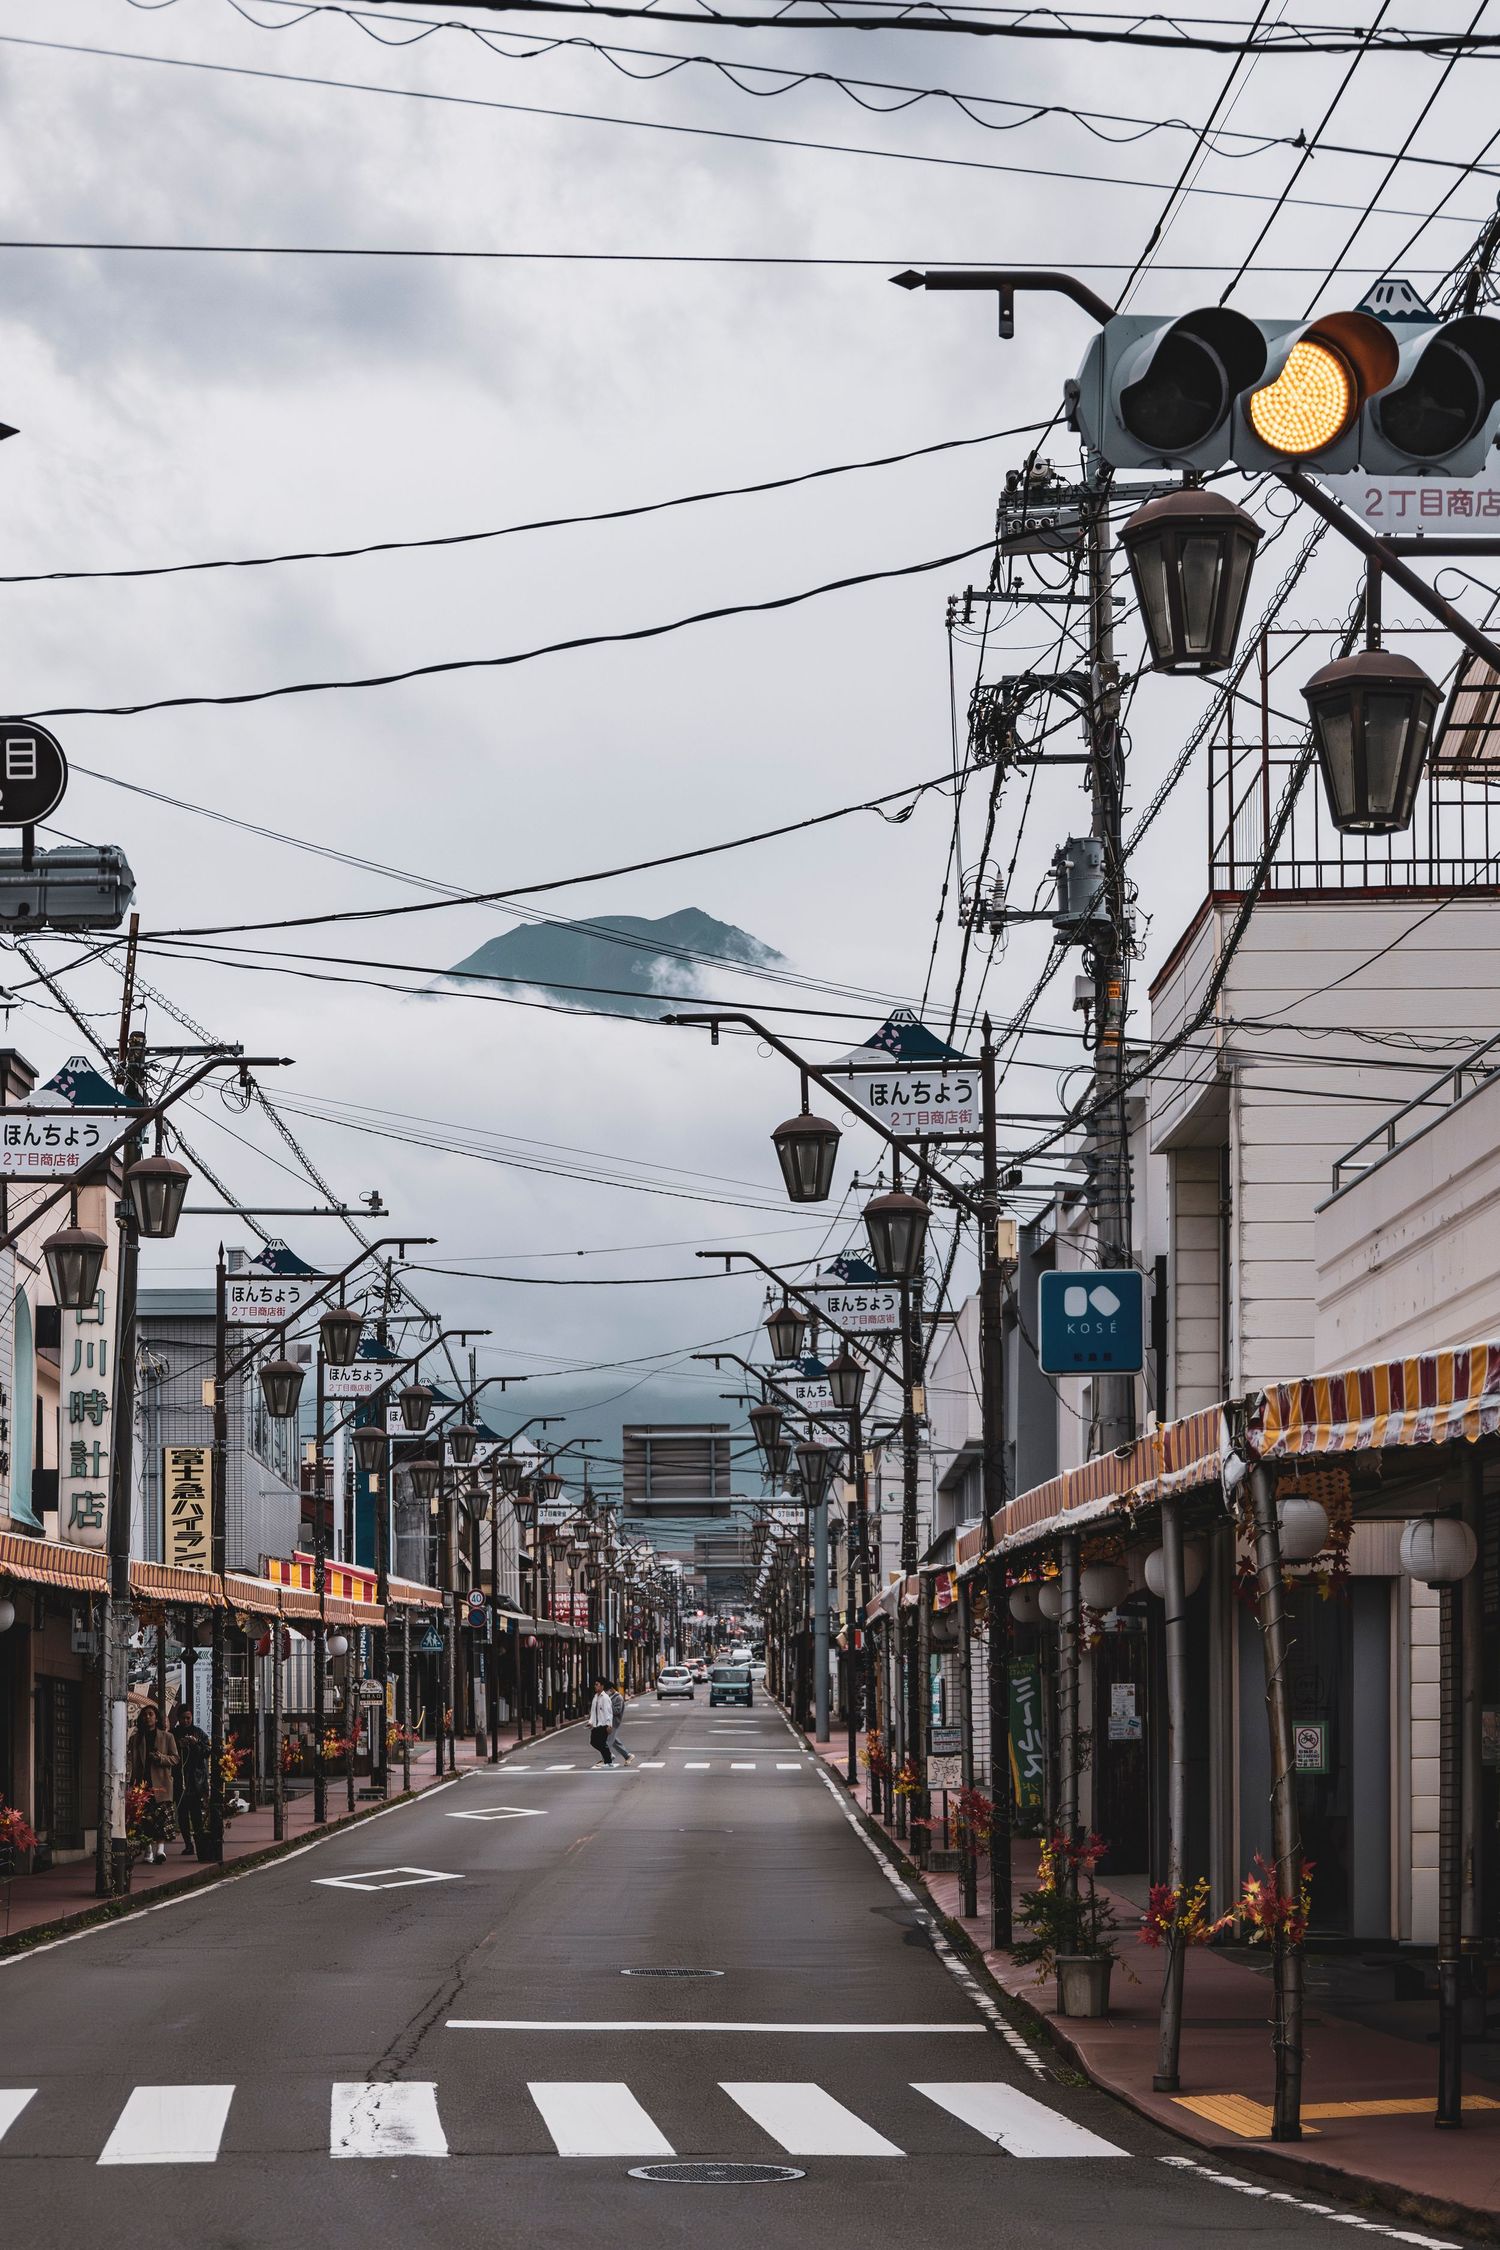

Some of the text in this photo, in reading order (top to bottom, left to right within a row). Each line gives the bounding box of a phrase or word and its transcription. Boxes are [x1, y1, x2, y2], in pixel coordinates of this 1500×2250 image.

[870, 1079, 973, 1106] ほんちょう
[891, 1109, 973, 1126] 2丁目商店街
[3, 1123, 100, 1147] ほんちょう
[3, 1152, 80, 1167] 2丁目商店街
[231, 1286, 300, 1303] ほんちょう
[828, 1294, 894, 1312] ほんちょう
[231, 1307, 286, 1316] 2丁目商店街
[842, 1313, 895, 1325] 2丁目商店街
[1067, 1320, 1117, 1334] KOSÉ
[329, 1368, 384, 1381] ほんちょう
[329, 1384, 372, 1392] 2丁目商店街
[796, 1385, 833, 1398] ほんち
[171, 1449, 206, 1571] 富士急ハイラン
[471, 1594, 481, 1602] 40
